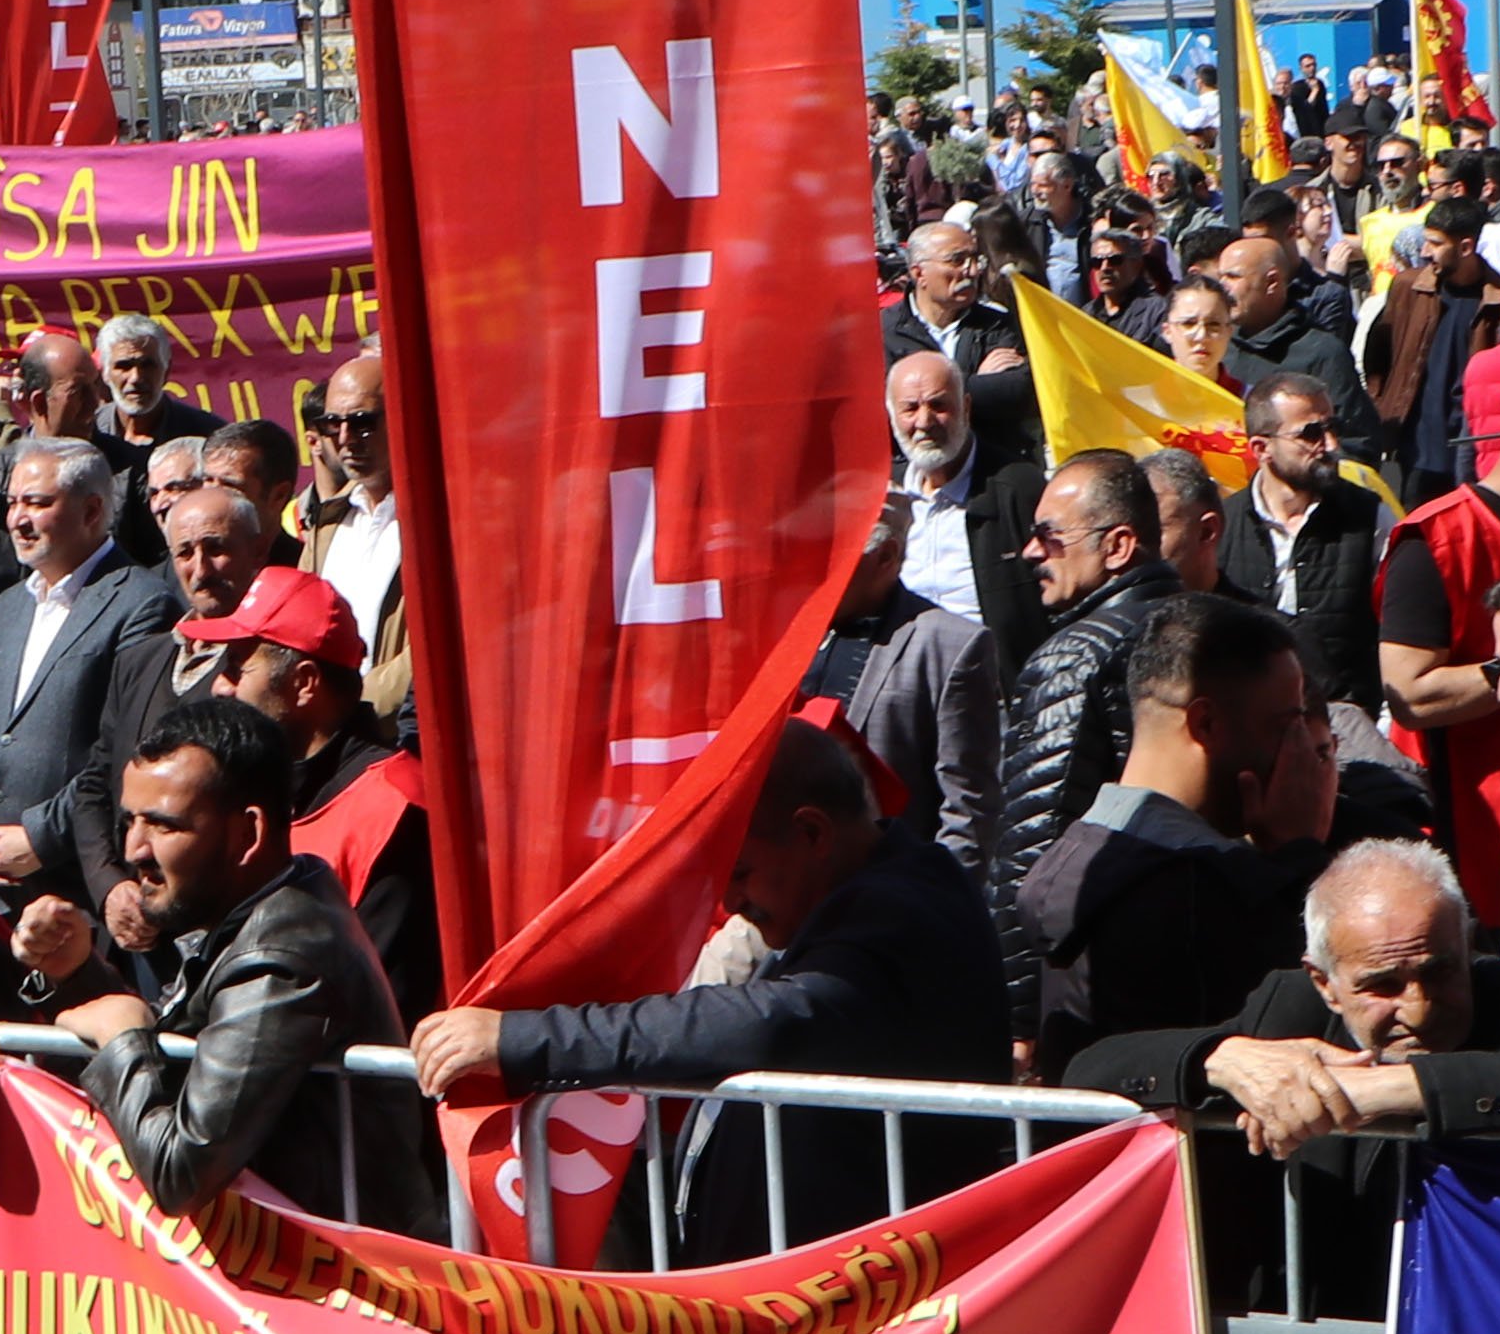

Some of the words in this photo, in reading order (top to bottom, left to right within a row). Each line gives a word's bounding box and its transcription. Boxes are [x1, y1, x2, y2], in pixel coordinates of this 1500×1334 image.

[159, 23, 203, 39] Fatura
[222, 18, 266, 34] Vizyon
[135, 157, 259, 259] JIN
